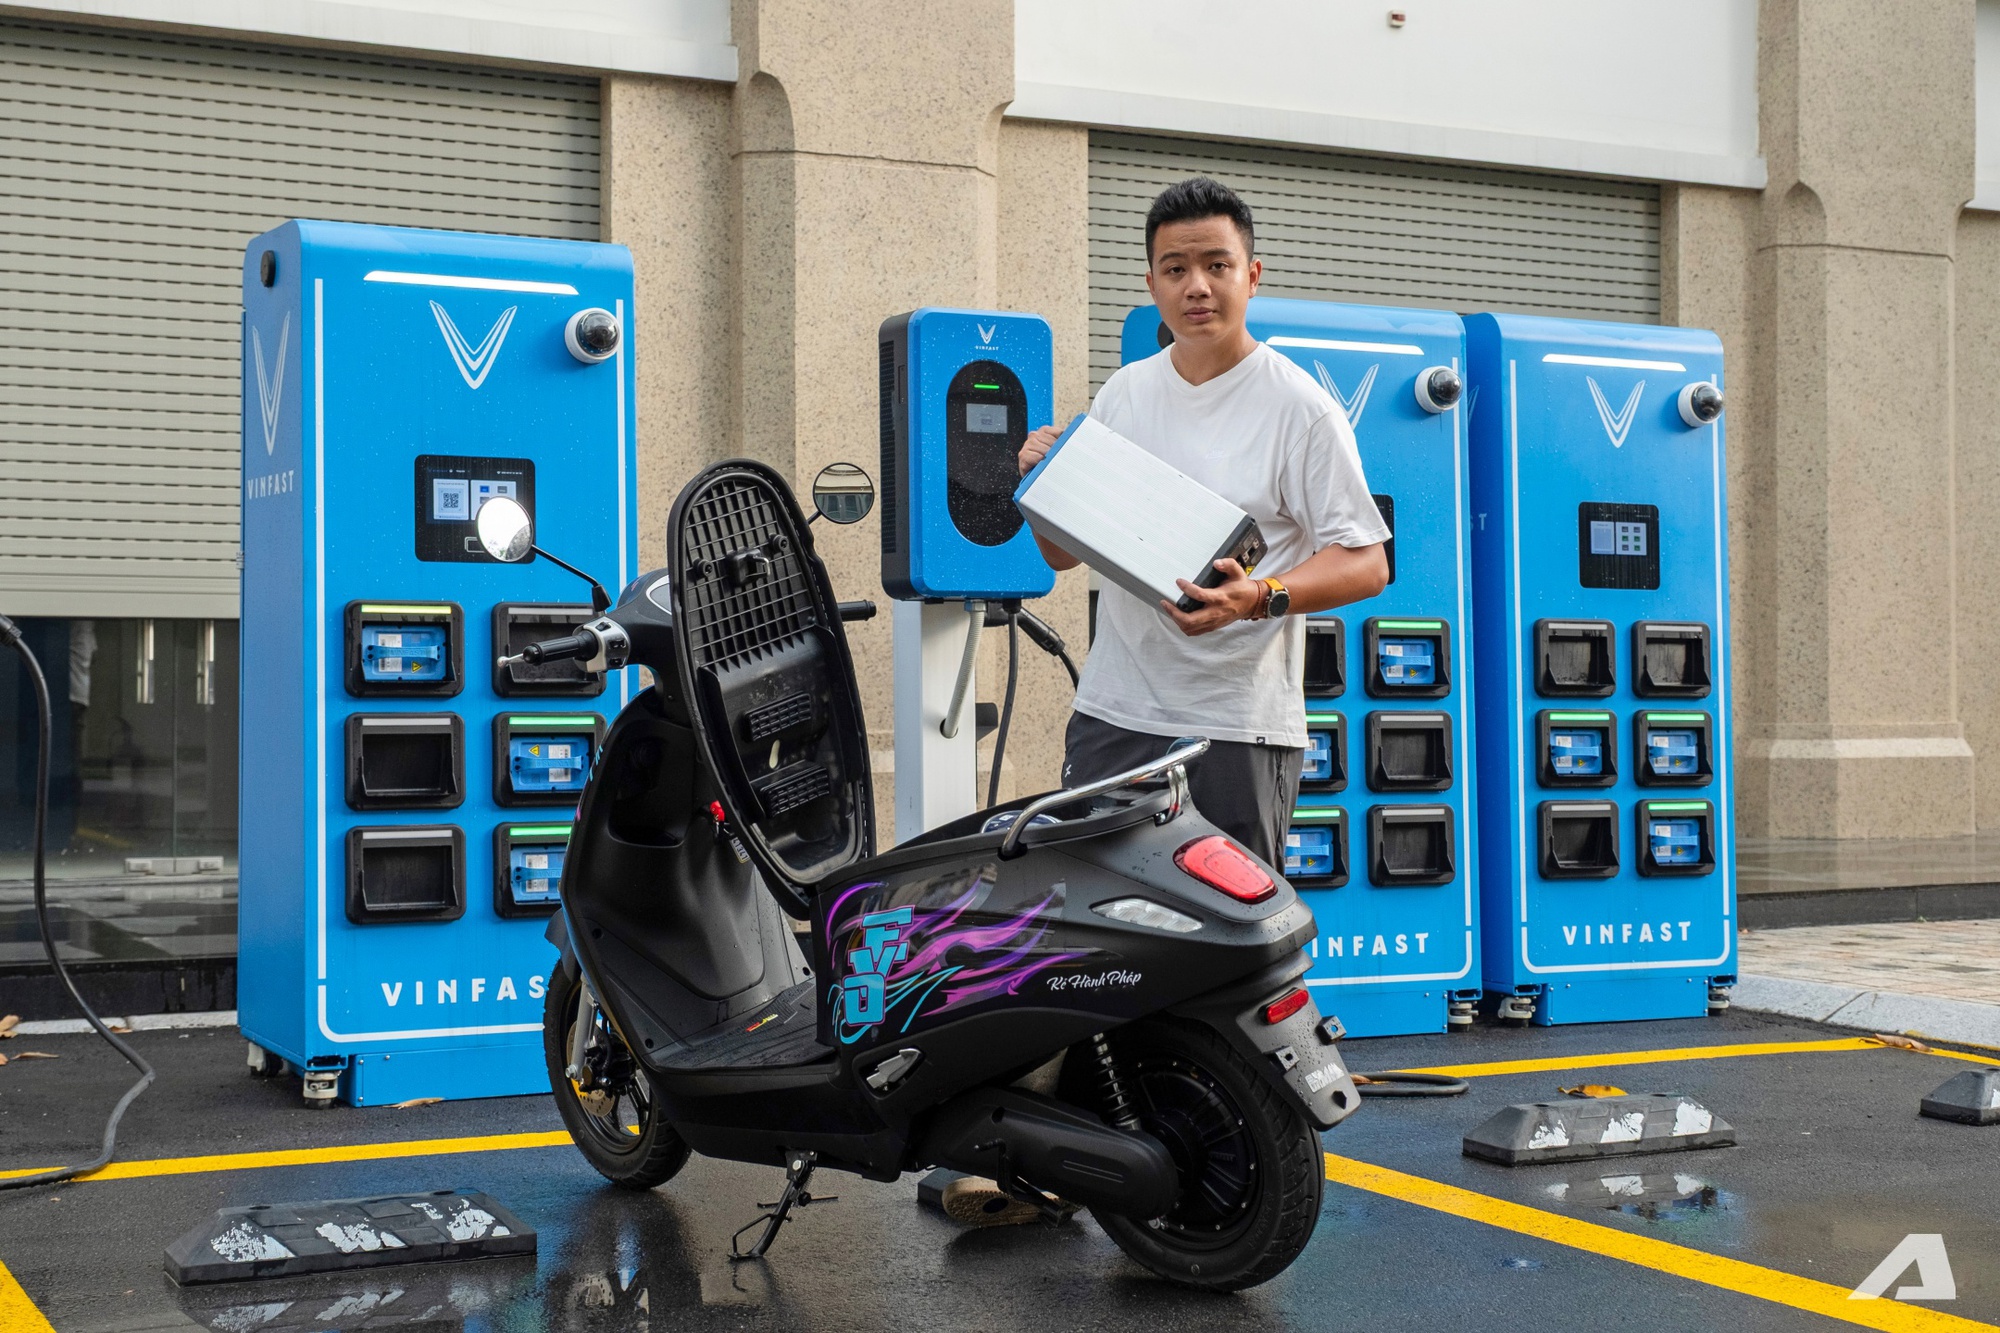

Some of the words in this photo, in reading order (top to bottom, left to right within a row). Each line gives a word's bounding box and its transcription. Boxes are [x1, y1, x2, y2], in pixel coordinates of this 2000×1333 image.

[247, 470, 294, 500] VINFAST
[1312, 933, 1429, 958] INFAST
[1562, 921, 1691, 946] VINFAST
[843, 905, 915, 1027] EVO
[1068, 972, 1106, 989] Hành
[1106, 970, 1142, 986] Pháp
[381, 975, 545, 1007] VINFAS
